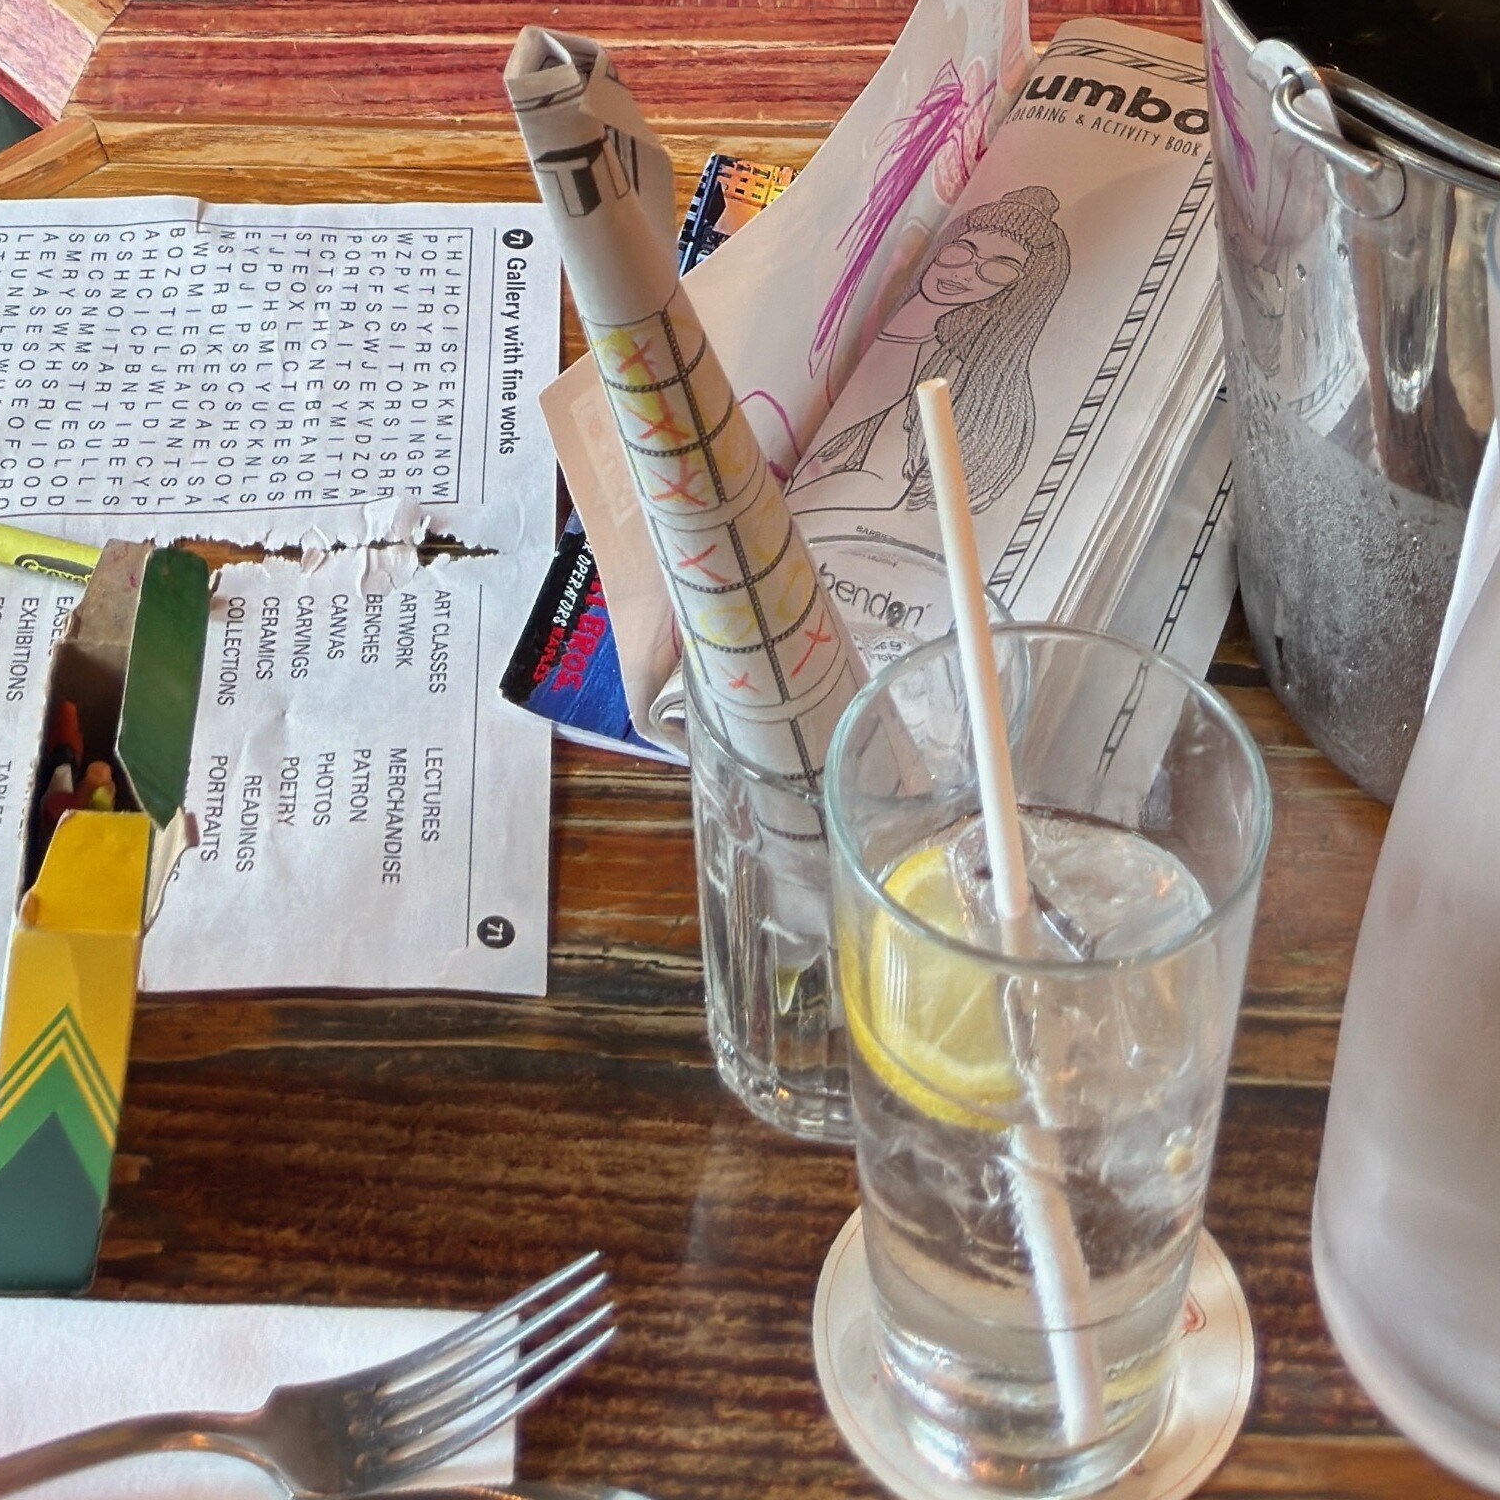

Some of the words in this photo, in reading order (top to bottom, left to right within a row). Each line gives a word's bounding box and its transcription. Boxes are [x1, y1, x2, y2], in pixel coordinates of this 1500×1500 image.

[1075, 114, 1085, 126] &
[1090, 116, 1161, 147] ACTIVITY
[1165, 135, 1202, 157] BOOK
[511, 233, 522, 244] 71
[501, 258, 526, 319] Gallery
[503, 325, 523, 364] with
[502, 369, 522, 400] fine
[499, 407, 520, 454] works
[327, 594, 348, 659] CANVAS
[433, 590, 451, 618] ART
[552, 554, 592, 628] OPERATORS
[6, 598, 39, 701] EXHIBITIONS
[217, 597, 246, 706] COLLECTIONS
[255, 597, 280, 680] CERAMICS
[291, 596, 314, 679] CARVINGS
[361, 594, 382, 664] BENCHES
[395, 593, 417, 668] ARTWORK
[428, 623, 449, 693] CLASSES
[200, 755, 228, 862] PORTRAITS
[277, 757, 300, 827] POETRY
[312, 752, 335, 826] PHOTOS
[349, 749, 371, 822] PATRON
[382, 747, 407, 884] MERCHANDISE
[421, 747, 443, 842] LECTURES
[236, 775, 262, 872] READINGS
[486, 922, 503, 941] 71
